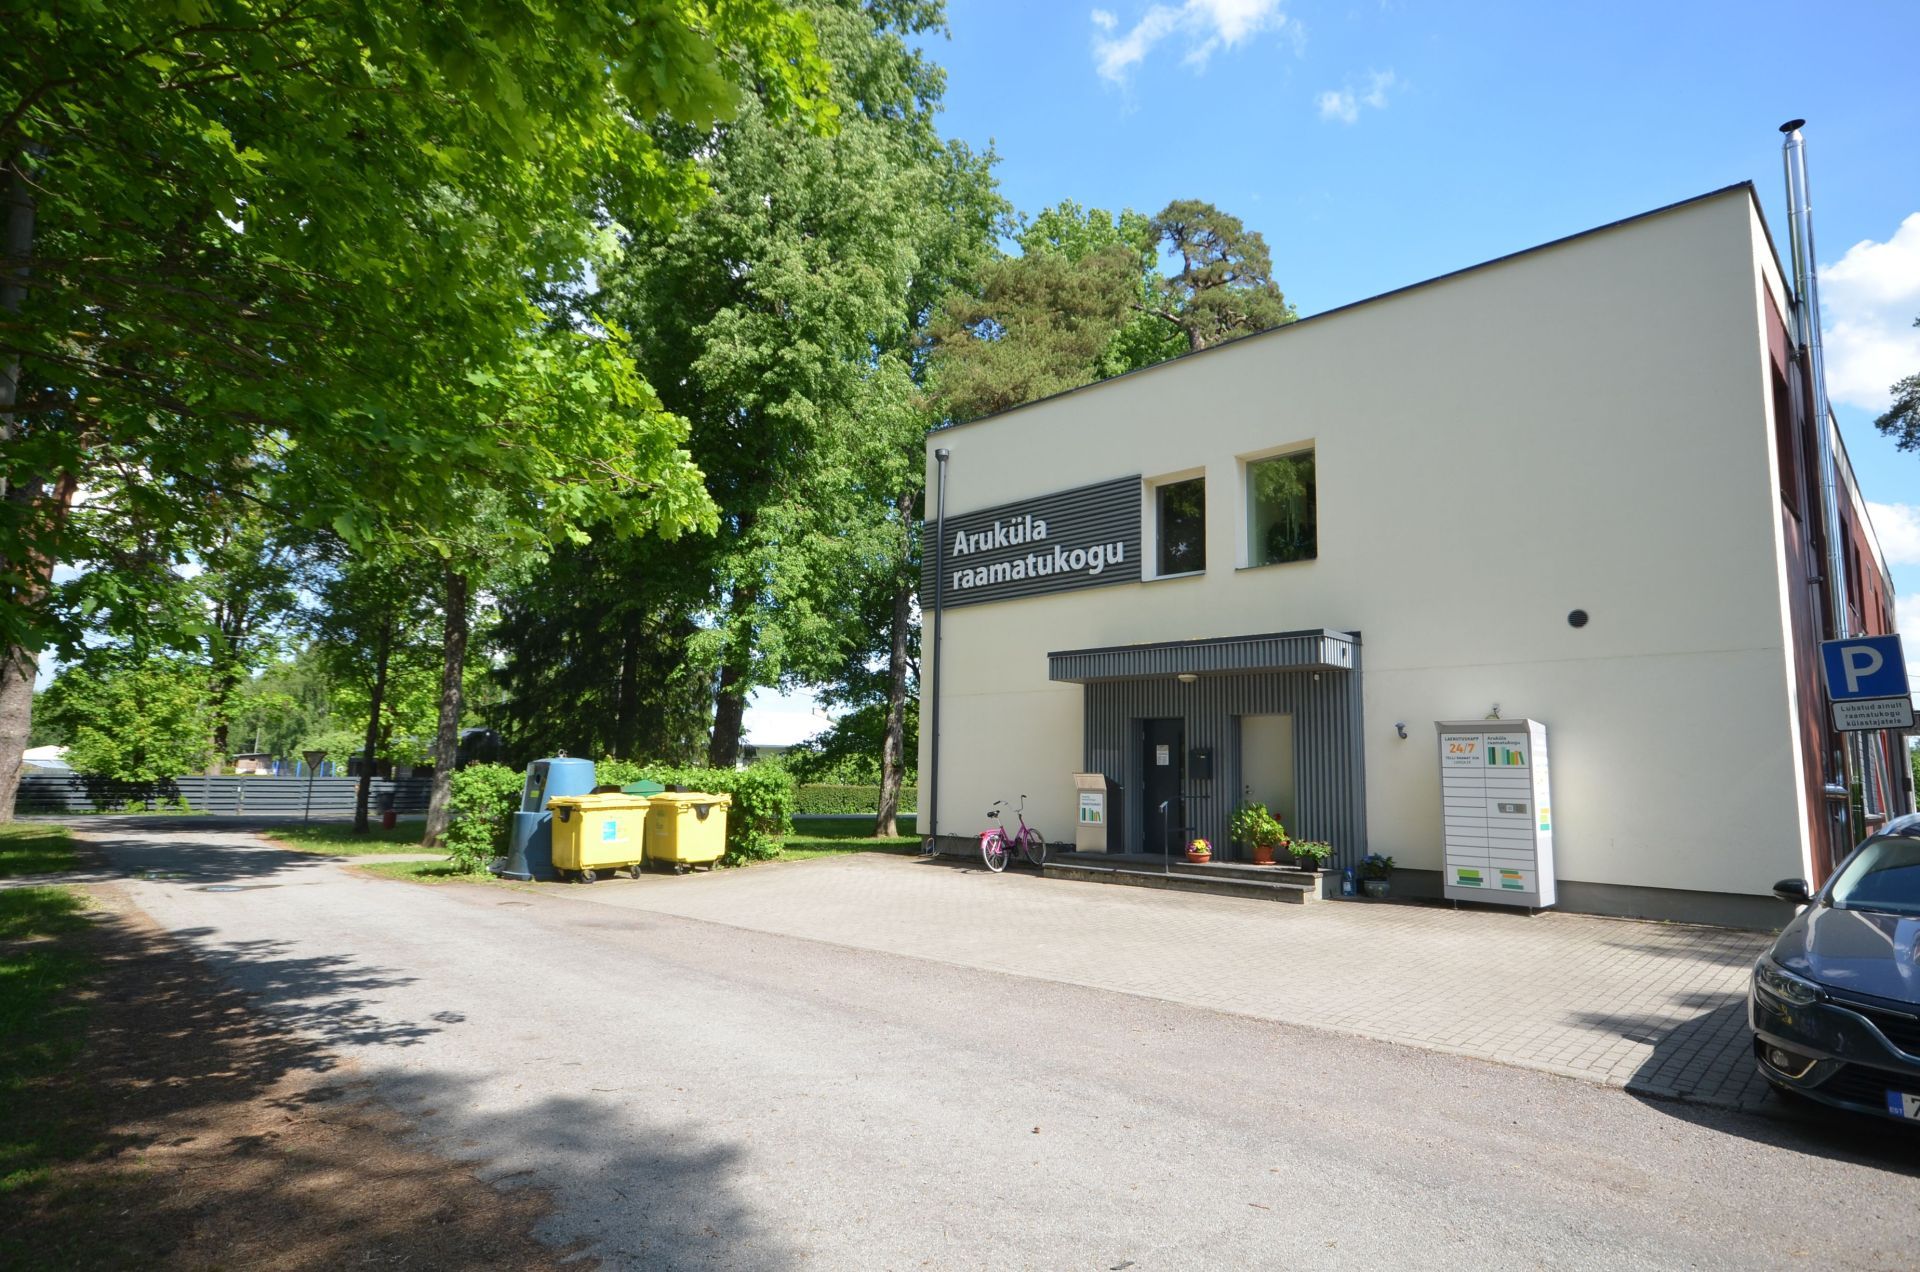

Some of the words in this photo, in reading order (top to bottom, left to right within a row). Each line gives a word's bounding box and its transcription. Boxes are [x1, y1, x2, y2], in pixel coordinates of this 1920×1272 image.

[953, 514, 1047, 557] Aruküla
[952, 541, 1124, 590] raamatukogu
[1841, 645, 1883, 692] P
[1840, 703, 1875, 711] Lubatud
[1845, 711, 1900, 719] raamatukogu
[1846, 718, 1902, 726] külastajatele
[1449, 743, 1475, 753] 24/7
